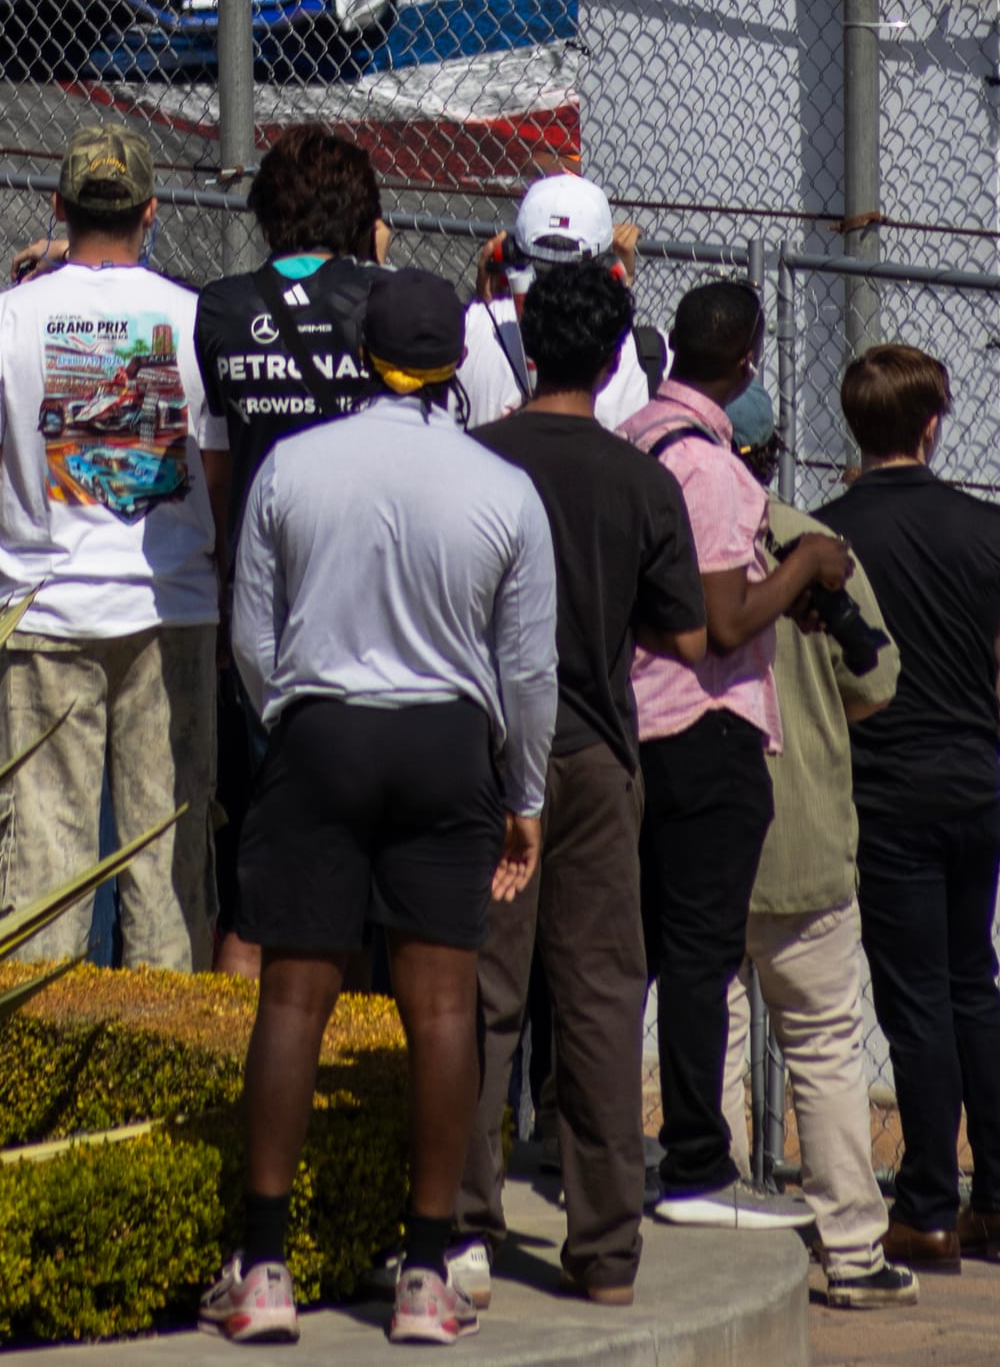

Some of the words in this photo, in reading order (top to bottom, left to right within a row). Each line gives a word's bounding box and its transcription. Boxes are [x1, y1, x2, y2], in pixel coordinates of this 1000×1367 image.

[47, 321, 94, 334] GRAND
[97, 321, 128, 334] PRIX
[217, 354, 370, 381] PETRNA
